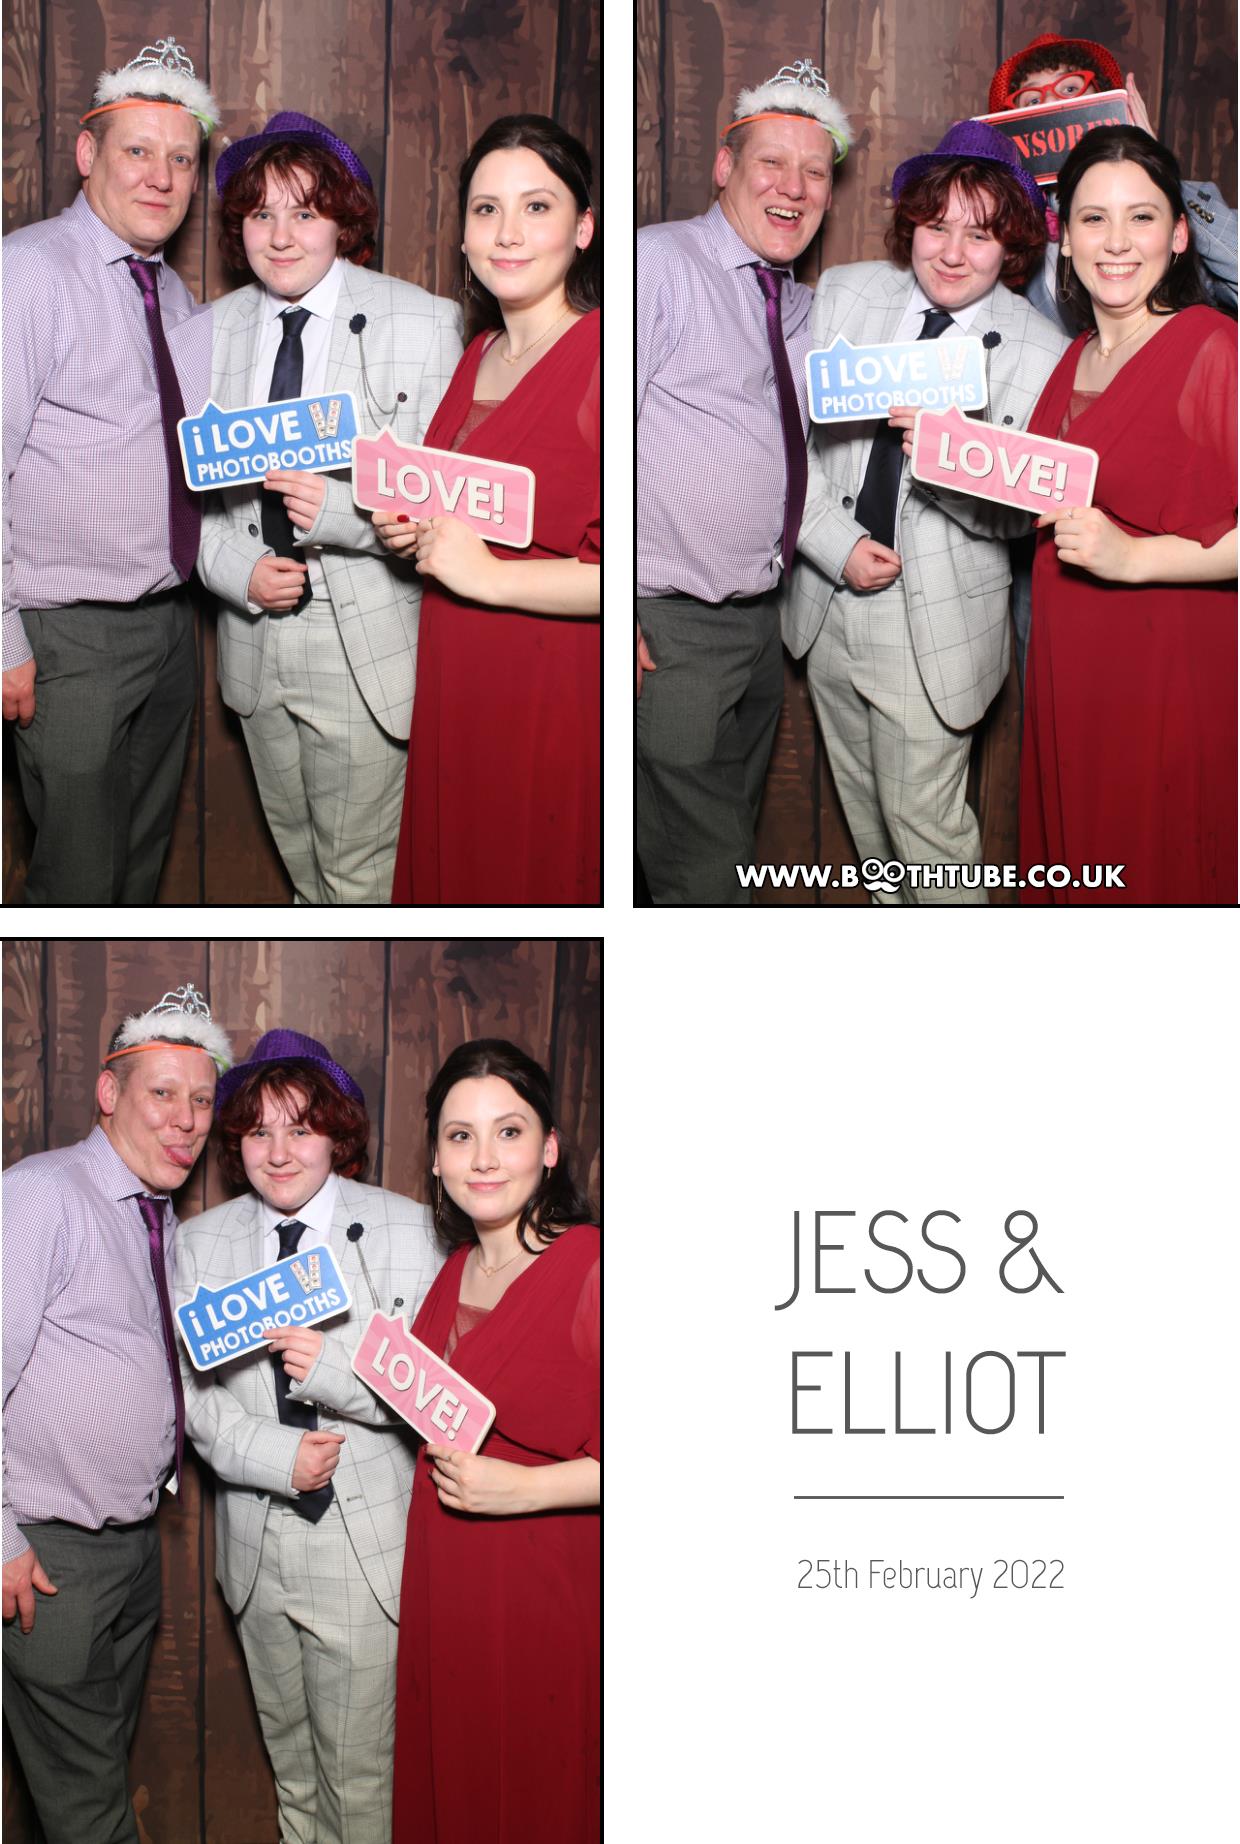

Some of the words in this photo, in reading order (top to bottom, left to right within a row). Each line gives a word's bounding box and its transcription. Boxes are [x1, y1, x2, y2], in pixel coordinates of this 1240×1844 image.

[839, 351, 928, 387] LOVE
[820, 383, 977, 415] PHOTOBOOTHS
[196, 439, 352, 482] PHOTOBOOTHS
[211, 410, 302, 453] LOVE
[376, 458, 505, 525] LOVE!
[938, 431, 1069, 502] LOVE!
[199, 1288, 342, 1361] PHOTOBOOTHS
[205, 1272, 291, 1331] LOVE
[371, 1336, 470, 1441] LOVE!
